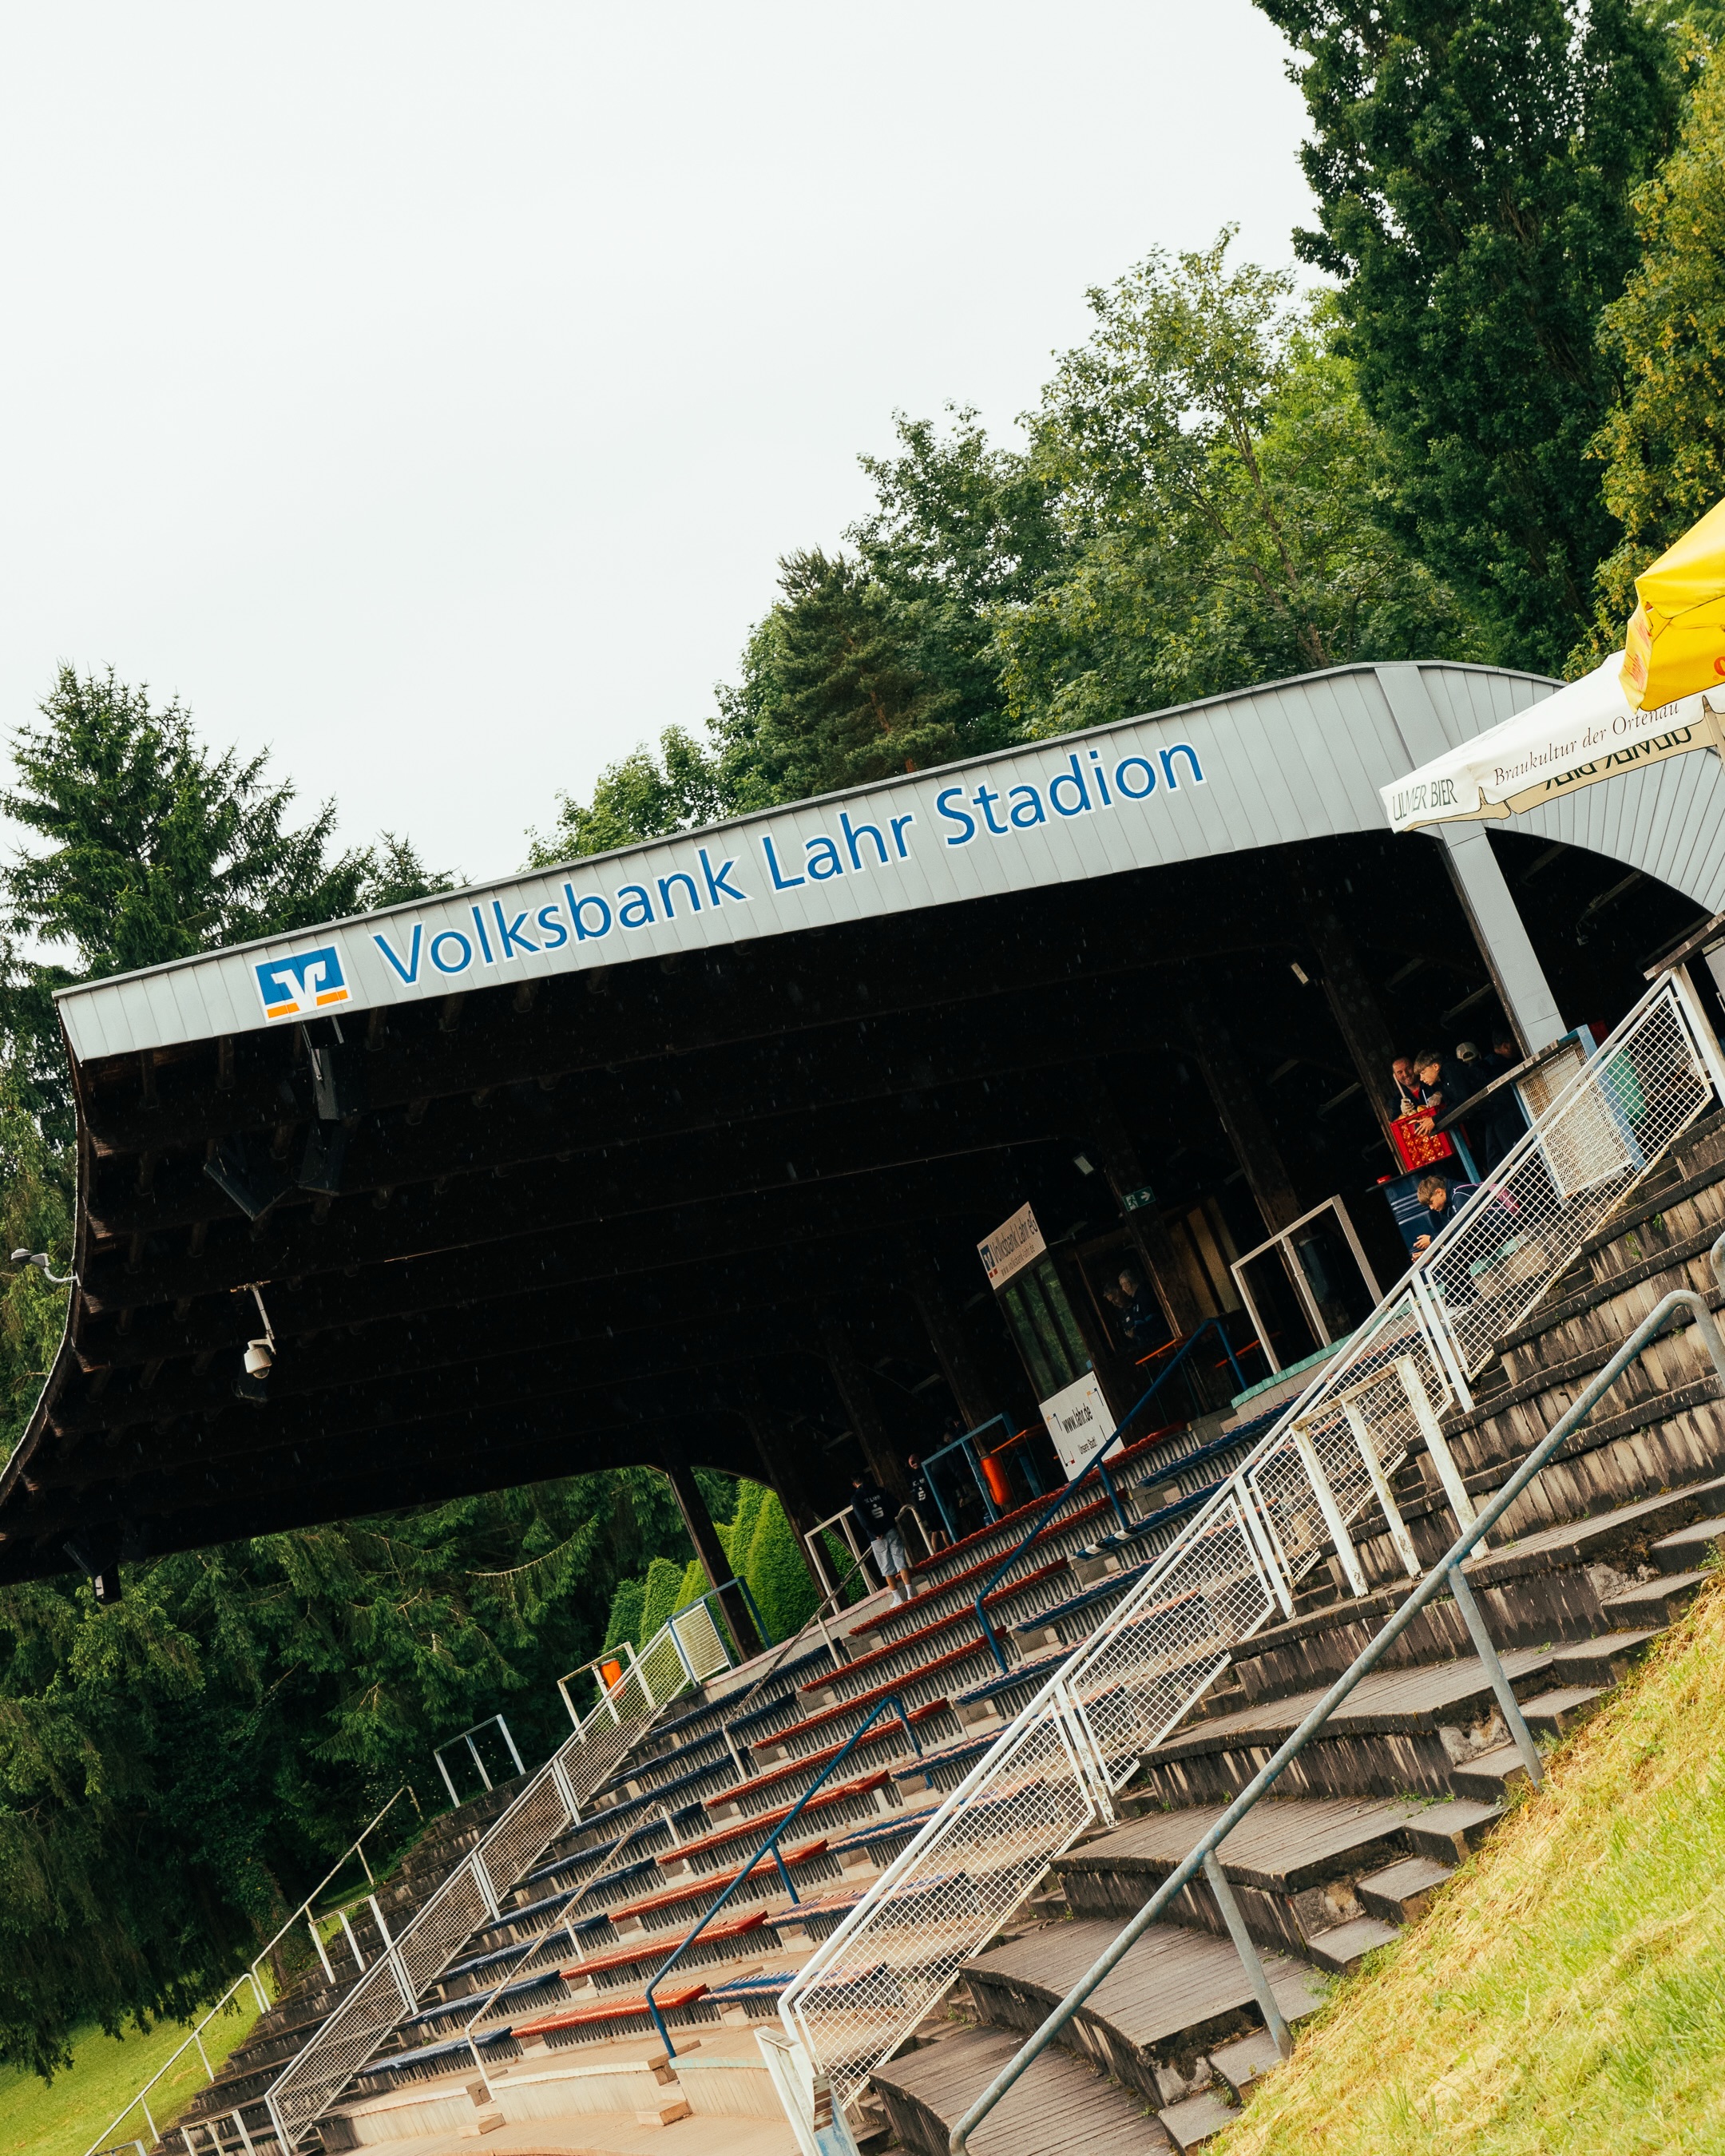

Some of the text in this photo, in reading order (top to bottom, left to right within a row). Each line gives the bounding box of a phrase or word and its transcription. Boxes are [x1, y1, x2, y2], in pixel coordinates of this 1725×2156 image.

[1493, 741, 1578, 787] Braukultur
[1582, 727, 1607, 748] der
[1612, 703, 1679, 735] Ortenau
[1393, 779, 1458, 821] ULMER BIER
[371, 743, 1205, 984] Volksbank Lahr Stadion
[989, 1211, 1038, 1263] Volksbank Lahr eG
[1062, 1403, 1093, 1434] www.lahr.de
